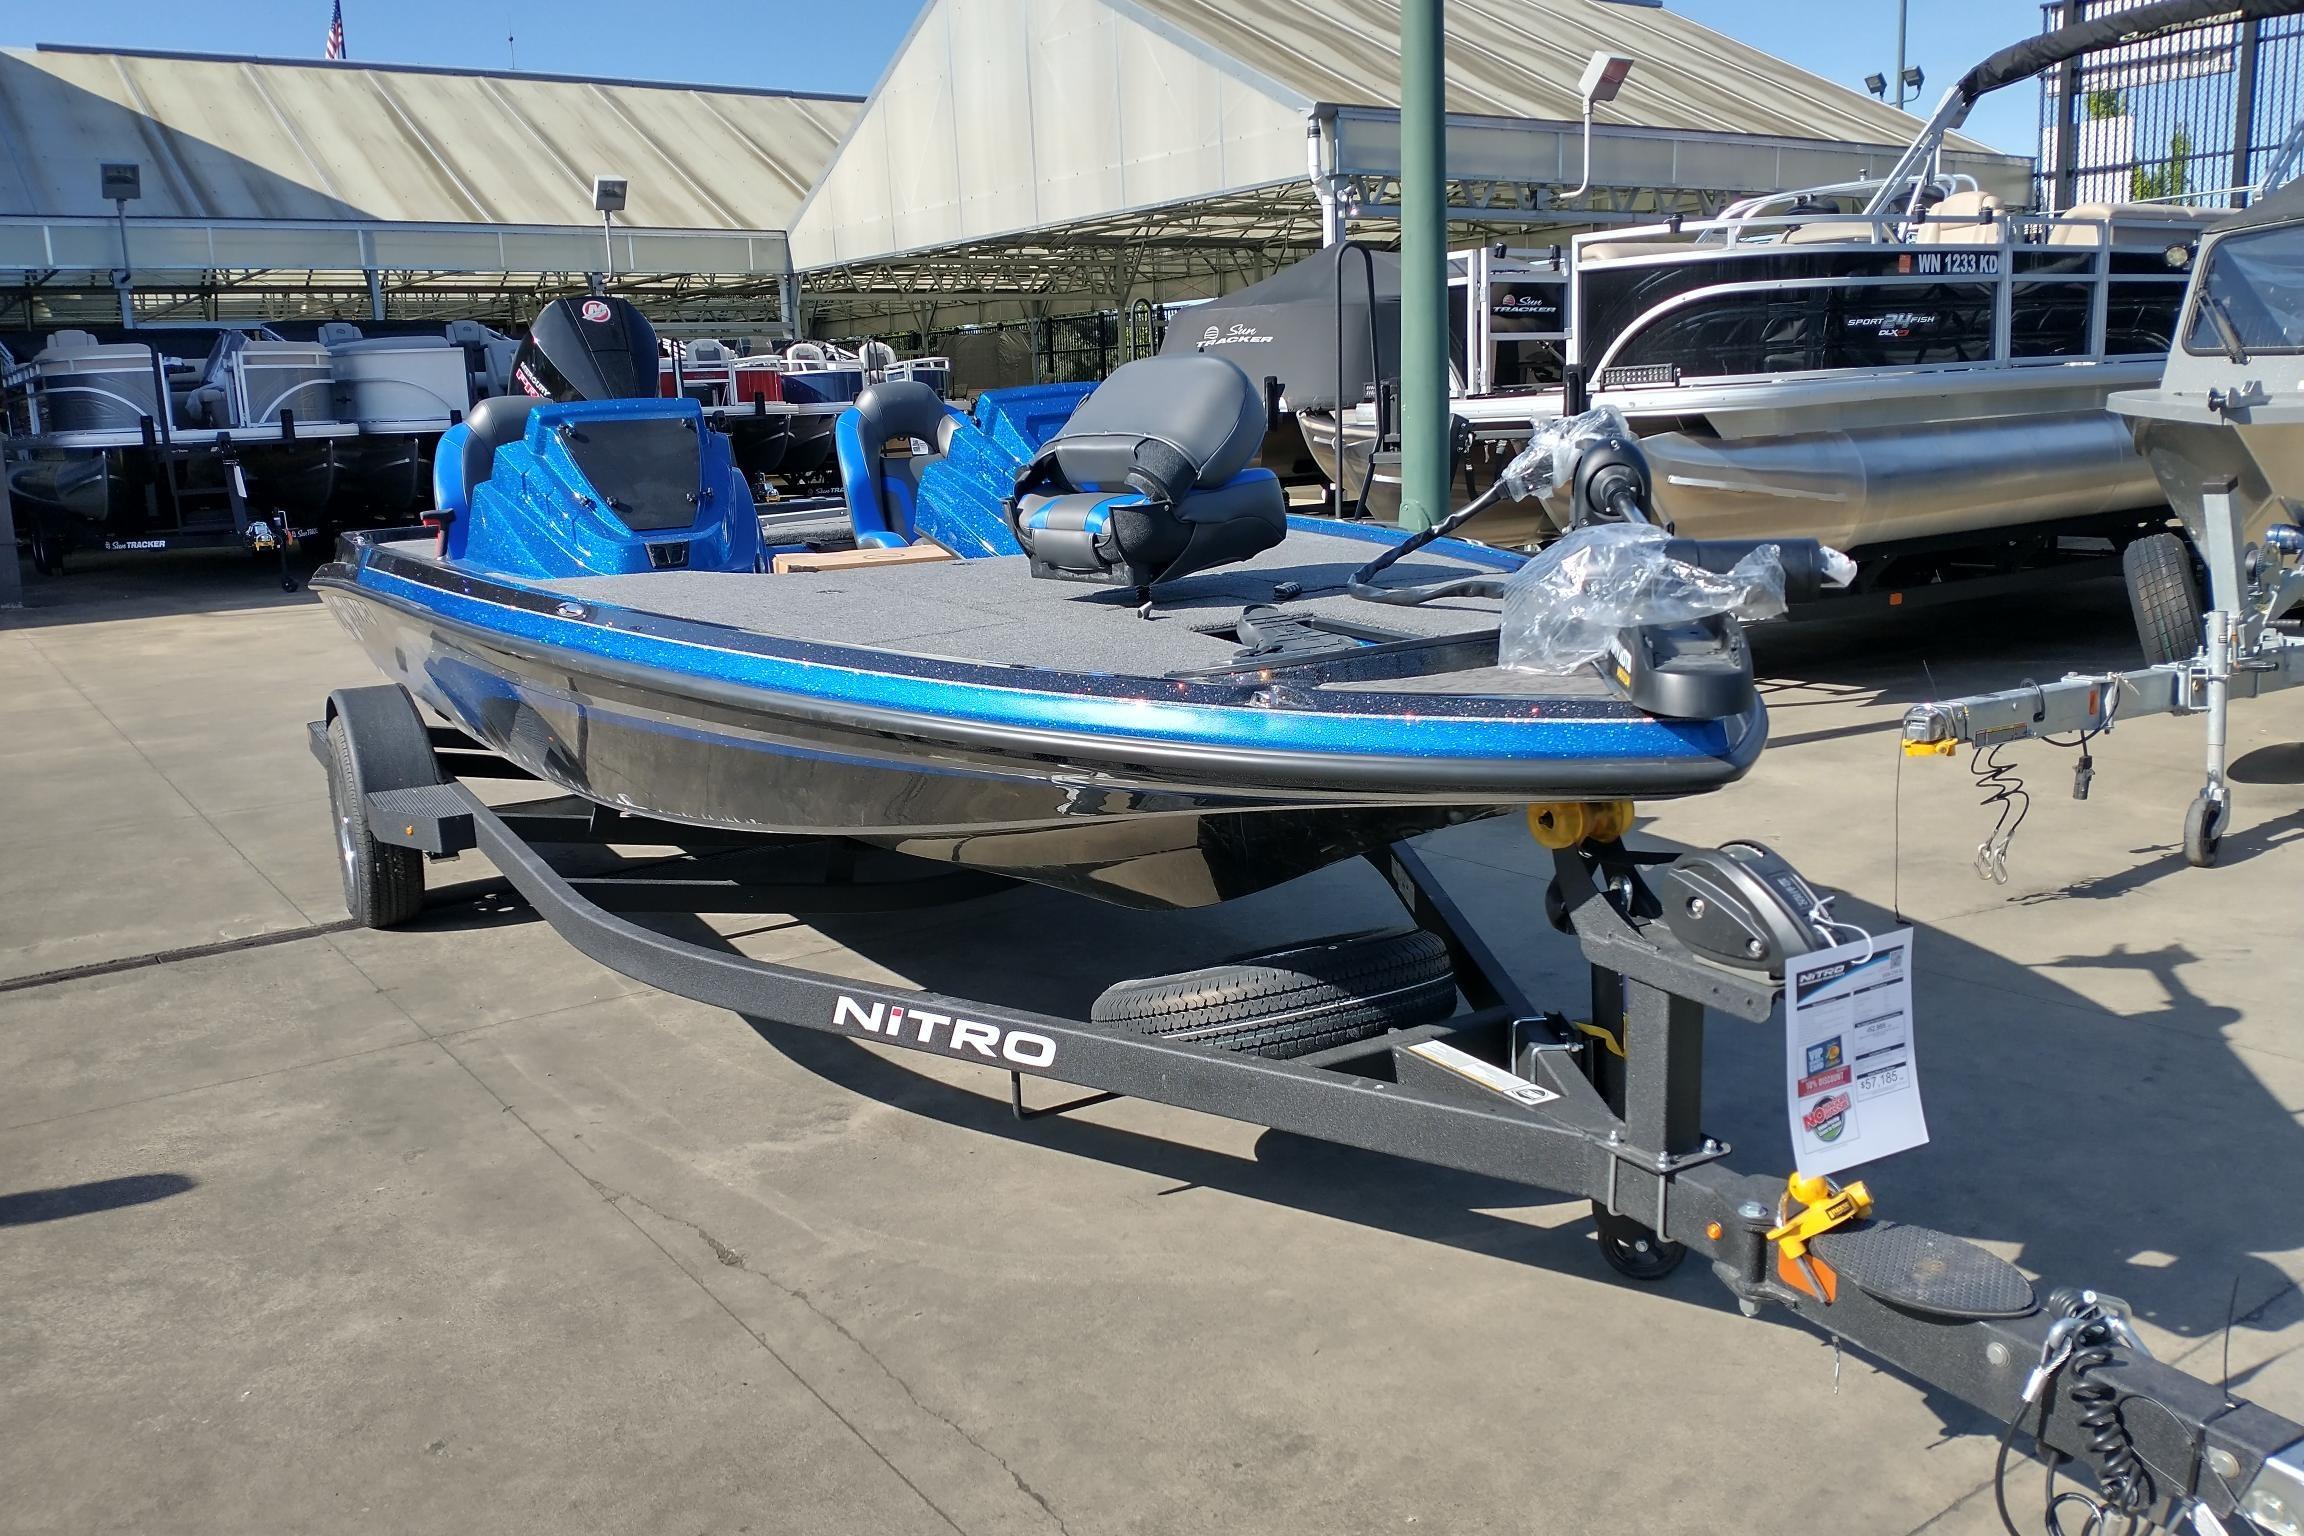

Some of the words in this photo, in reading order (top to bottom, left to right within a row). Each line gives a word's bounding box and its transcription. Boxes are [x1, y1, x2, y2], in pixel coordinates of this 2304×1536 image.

[2160, 10, 2243, 33] TRACKER
[1918, 253, 1941, 273] WN
[1944, 253, 1977, 273] 1233
[1980, 254, 1998, 274] KD
[1516, 296, 1544, 306] Sun
[1847, 318, 1884, 326] SPORT
[1880, 312, 1914, 330] 24
[1910, 315, 1936, 324] FISH
[1226, 323, 1257, 336] Sun
[1195, 336, 1274, 348] TRACKER
[520, 361, 551, 396] MERCURY
[126, 540, 166, 549] TRACKER
